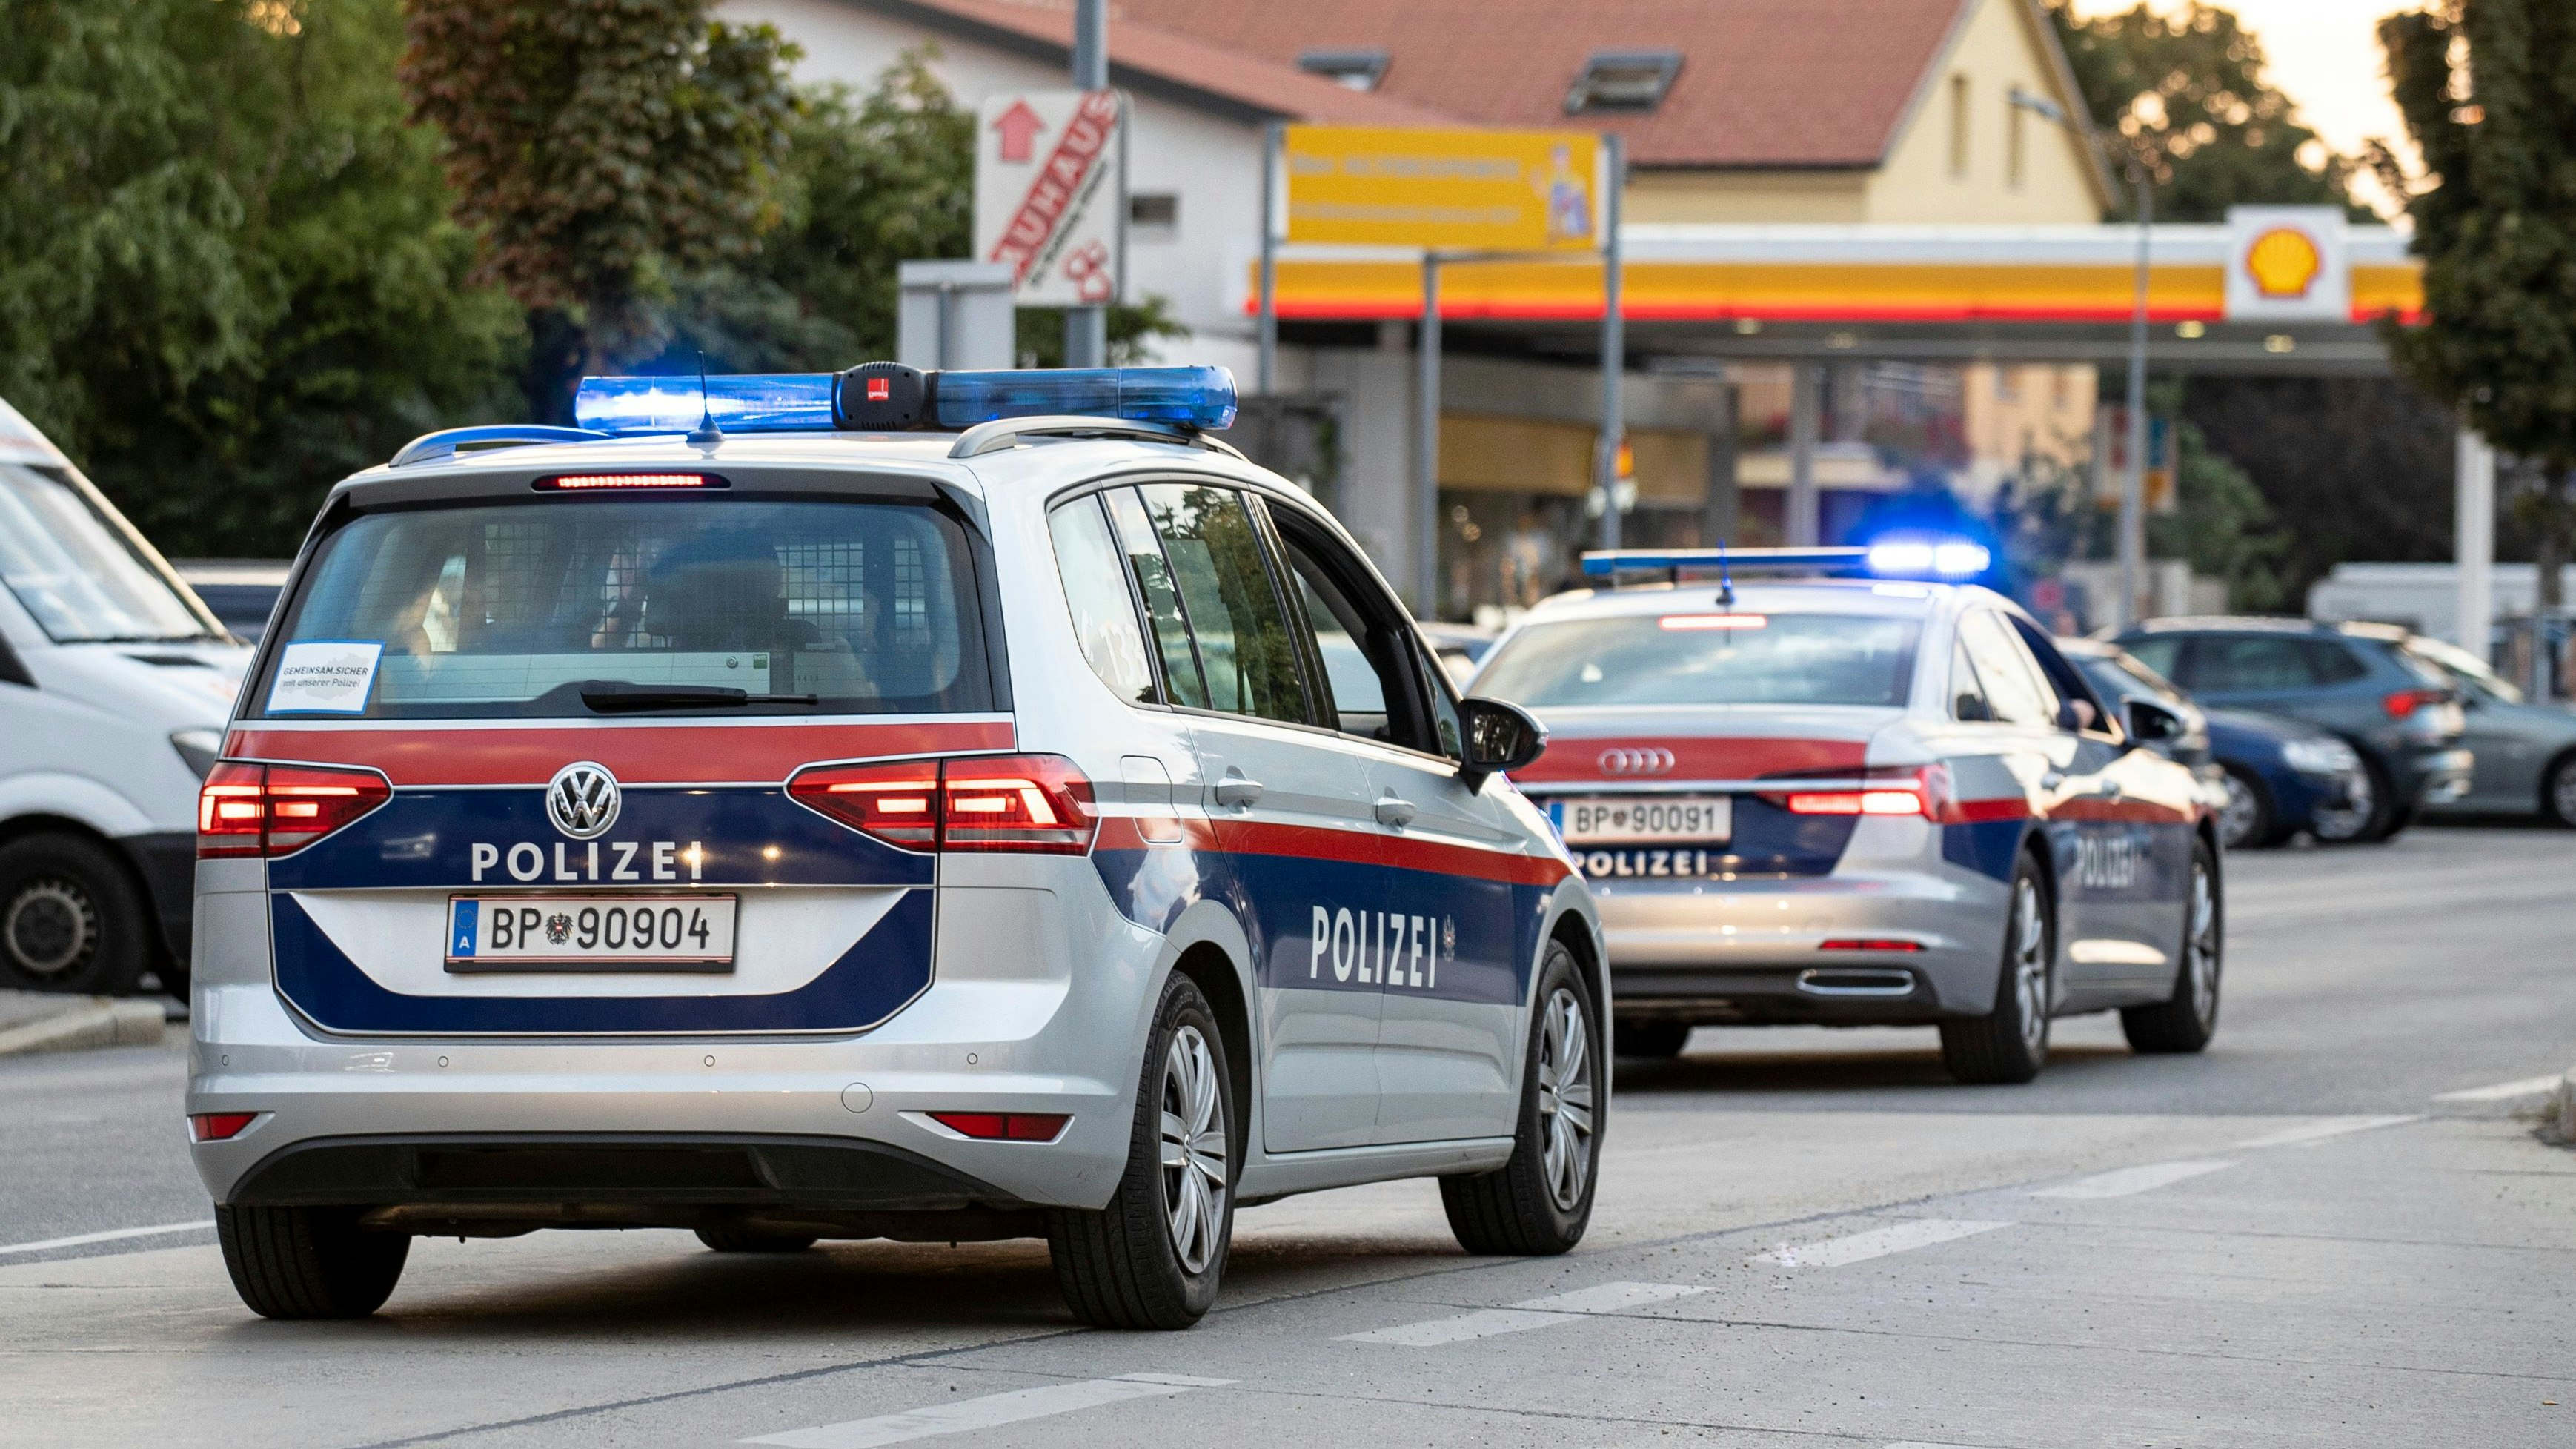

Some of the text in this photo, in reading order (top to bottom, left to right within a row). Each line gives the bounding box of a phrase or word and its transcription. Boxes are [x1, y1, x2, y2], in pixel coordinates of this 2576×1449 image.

[992, 90, 1118, 282] AUHAUS
[282, 677, 361, 687] mit unserer Polizei
[1576, 806, 1715, 832] BP 90091
[472, 841, 702, 881] POLIZEI
[459, 908, 710, 949] A BP 90904
[1310, 905, 1437, 989] POLIZEI
